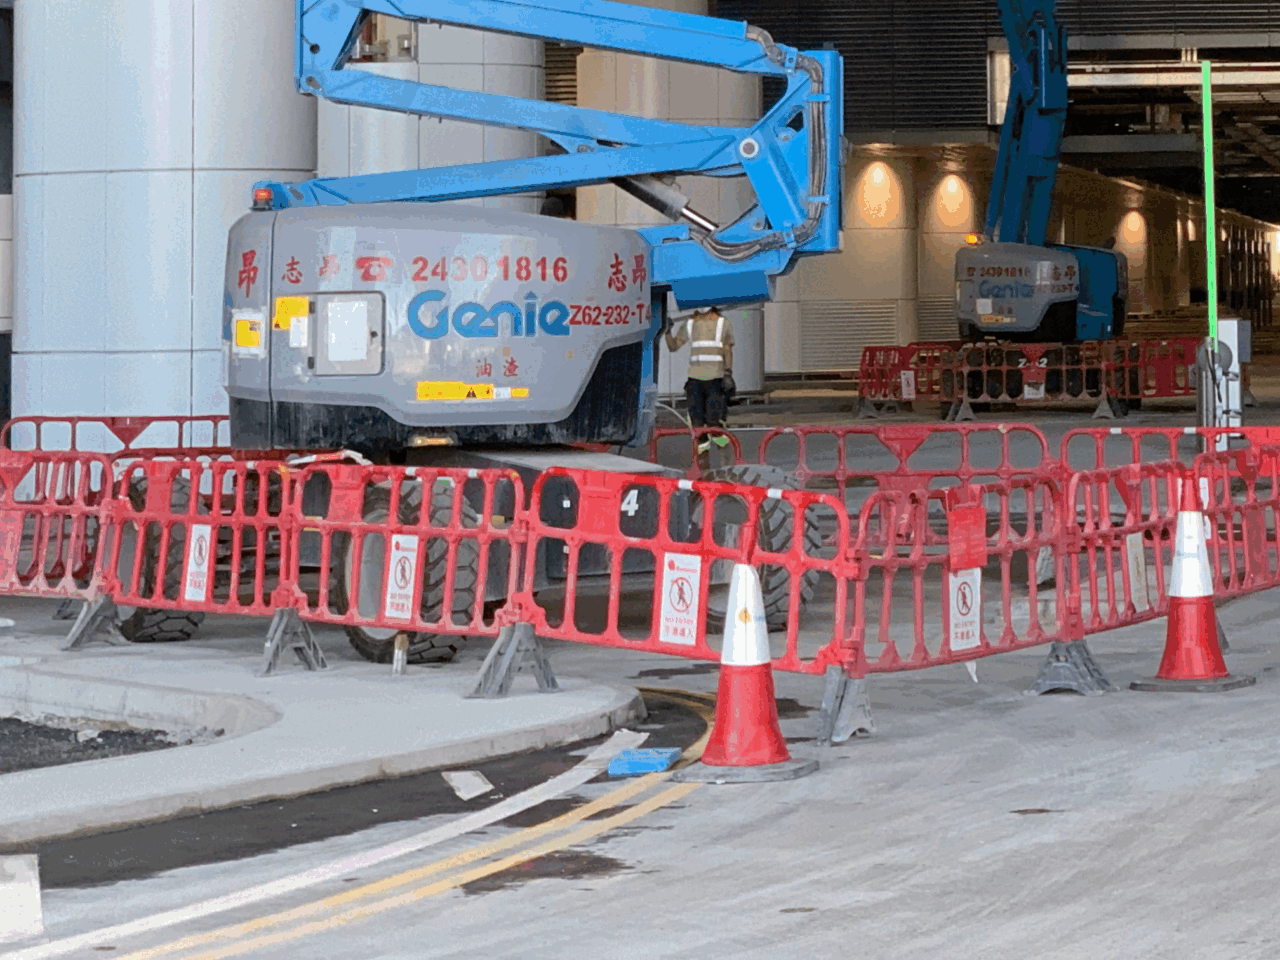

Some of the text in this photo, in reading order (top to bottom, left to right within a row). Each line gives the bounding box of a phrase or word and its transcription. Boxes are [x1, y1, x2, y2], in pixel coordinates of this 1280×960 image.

[411, 255, 568, 282] 2430 1816
[408, 289, 570, 340] Genie
